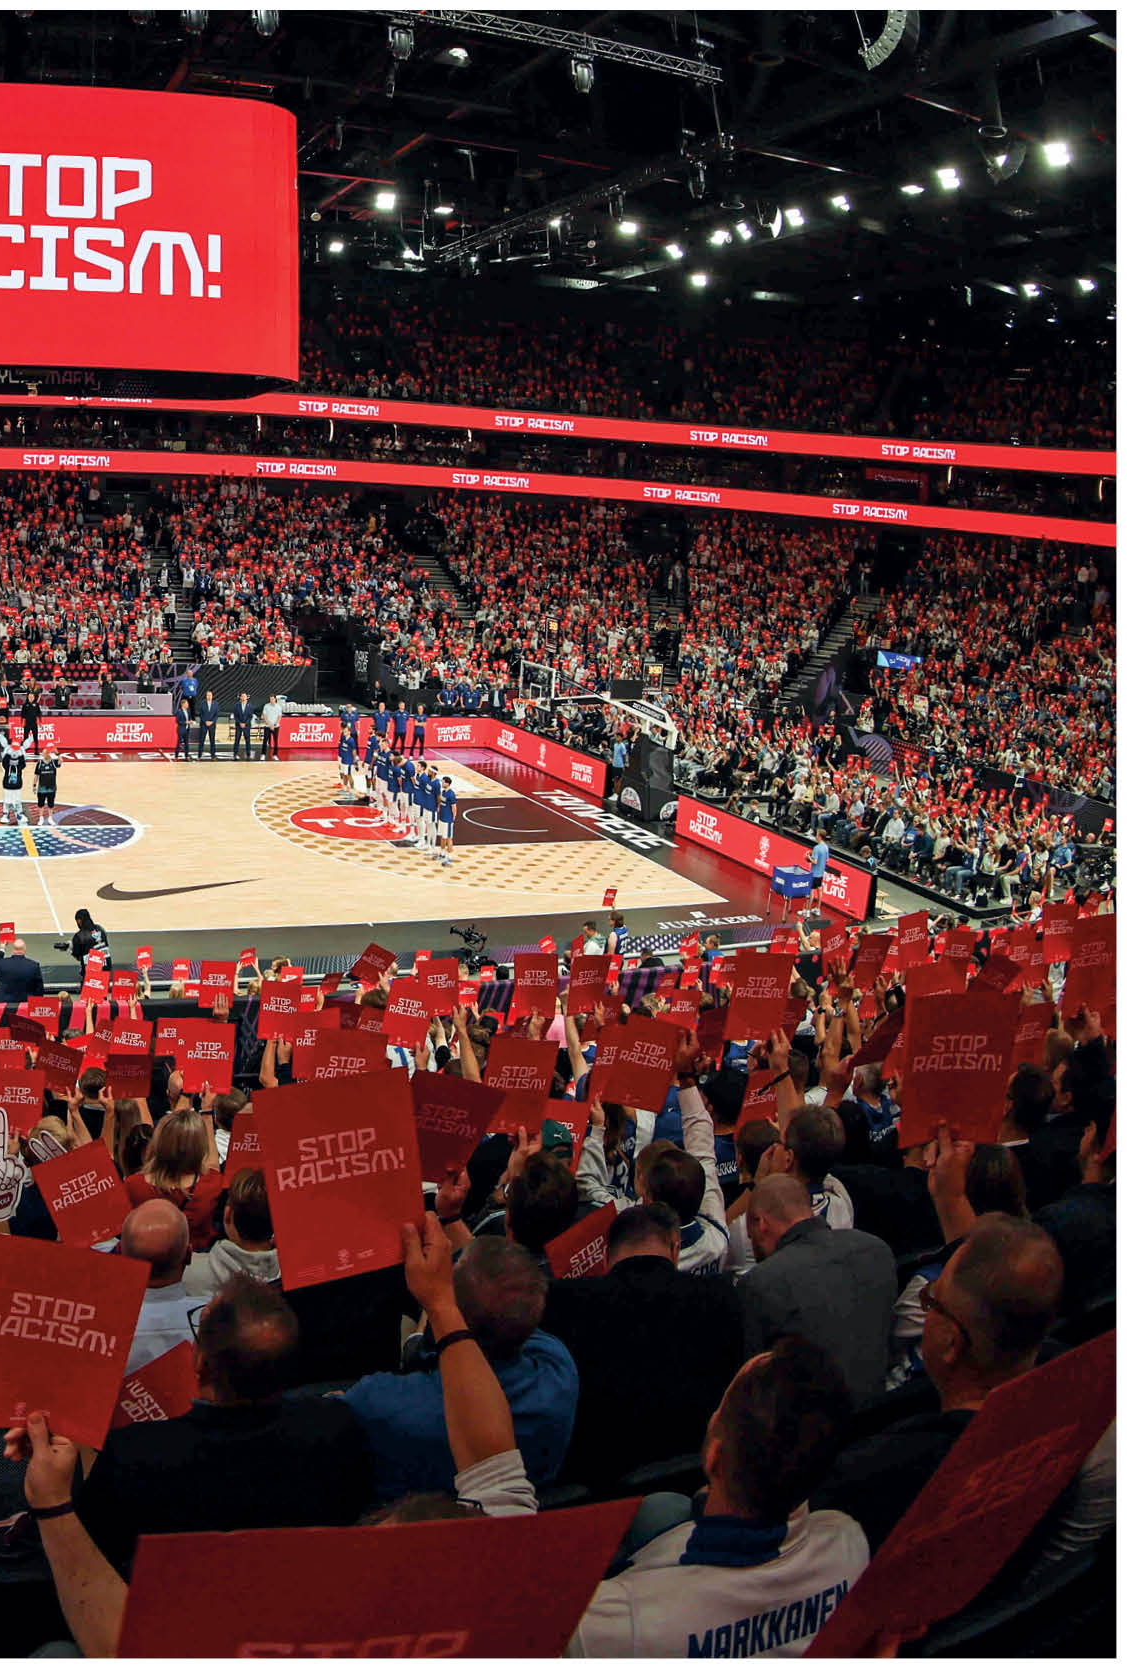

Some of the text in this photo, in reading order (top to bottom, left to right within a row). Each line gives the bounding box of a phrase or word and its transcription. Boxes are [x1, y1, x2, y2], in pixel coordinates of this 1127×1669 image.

[299, 401, 379, 416] STOP RACISM!
[494, 415, 575, 431] STOP RACISM!
[689, 430, 768, 447] STOP RACISM!
[880, 444, 956, 461] STOP RACISM!
[23, 453, 110, 468] STOP RACISM!
[256, 461, 337, 477] STOP RACISM!
[452, 472, 530, 489] STOP RACISM!
[643, 486, 721, 505] STOP RACISM!
[832, 503, 908, 521] STOP RACISM!
[115, 723, 144, 733] STOP
[298, 723, 326, 732] STOP
[106, 733, 153, 743] RACISM!
[290, 732, 334, 742] RACISM!
[532, 789, 680, 849] TAMPERE
[697, 810, 718, 827] STOP
[689, 820, 723, 845] RACISM!
[656, 914, 763, 930] JUNCKERS
[904, 927, 921, 936] STOP
[524, 970, 548, 978] STOP
[747, 976, 777, 987] STOP
[517, 978, 555, 987] RACISM!
[736, 987, 783, 999] RACISM!
[262, 1003, 297, 1014] RACISM!
[271, 997, 291, 1006] STOP
[398, 997, 423, 1008] STOP
[388, 1005, 429, 1018] RACISM!
[113, 1037, 147, 1048] RACISM!
[121, 1032, 142, 1040] STOP
[932, 1034, 987, 1052] STOP
[196, 1041, 222, 1051] STOP
[633, 1040, 666, 1056] STOP
[187, 1050, 230, 1061] RACISM!
[329, 1056, 366, 1068] STOP
[620, 1050, 672, 1071] RACISM!
[913, 1054, 1002, 1073] RACISM!
[501, 1066, 538, 1078] STOP
[488, 1076, 546, 1089] RACISM!
[4, 1086, 31, 1095] STOP
[297, 1127, 377, 1163] STOP
[276, 1147, 406, 1192] RACISM!
[59, 1171, 98, 1197] STOP
[52, 1176, 115, 1212] RACISM!
[570, 1235, 605, 1268] STOP
[10, 1291, 96, 1325] STOP
